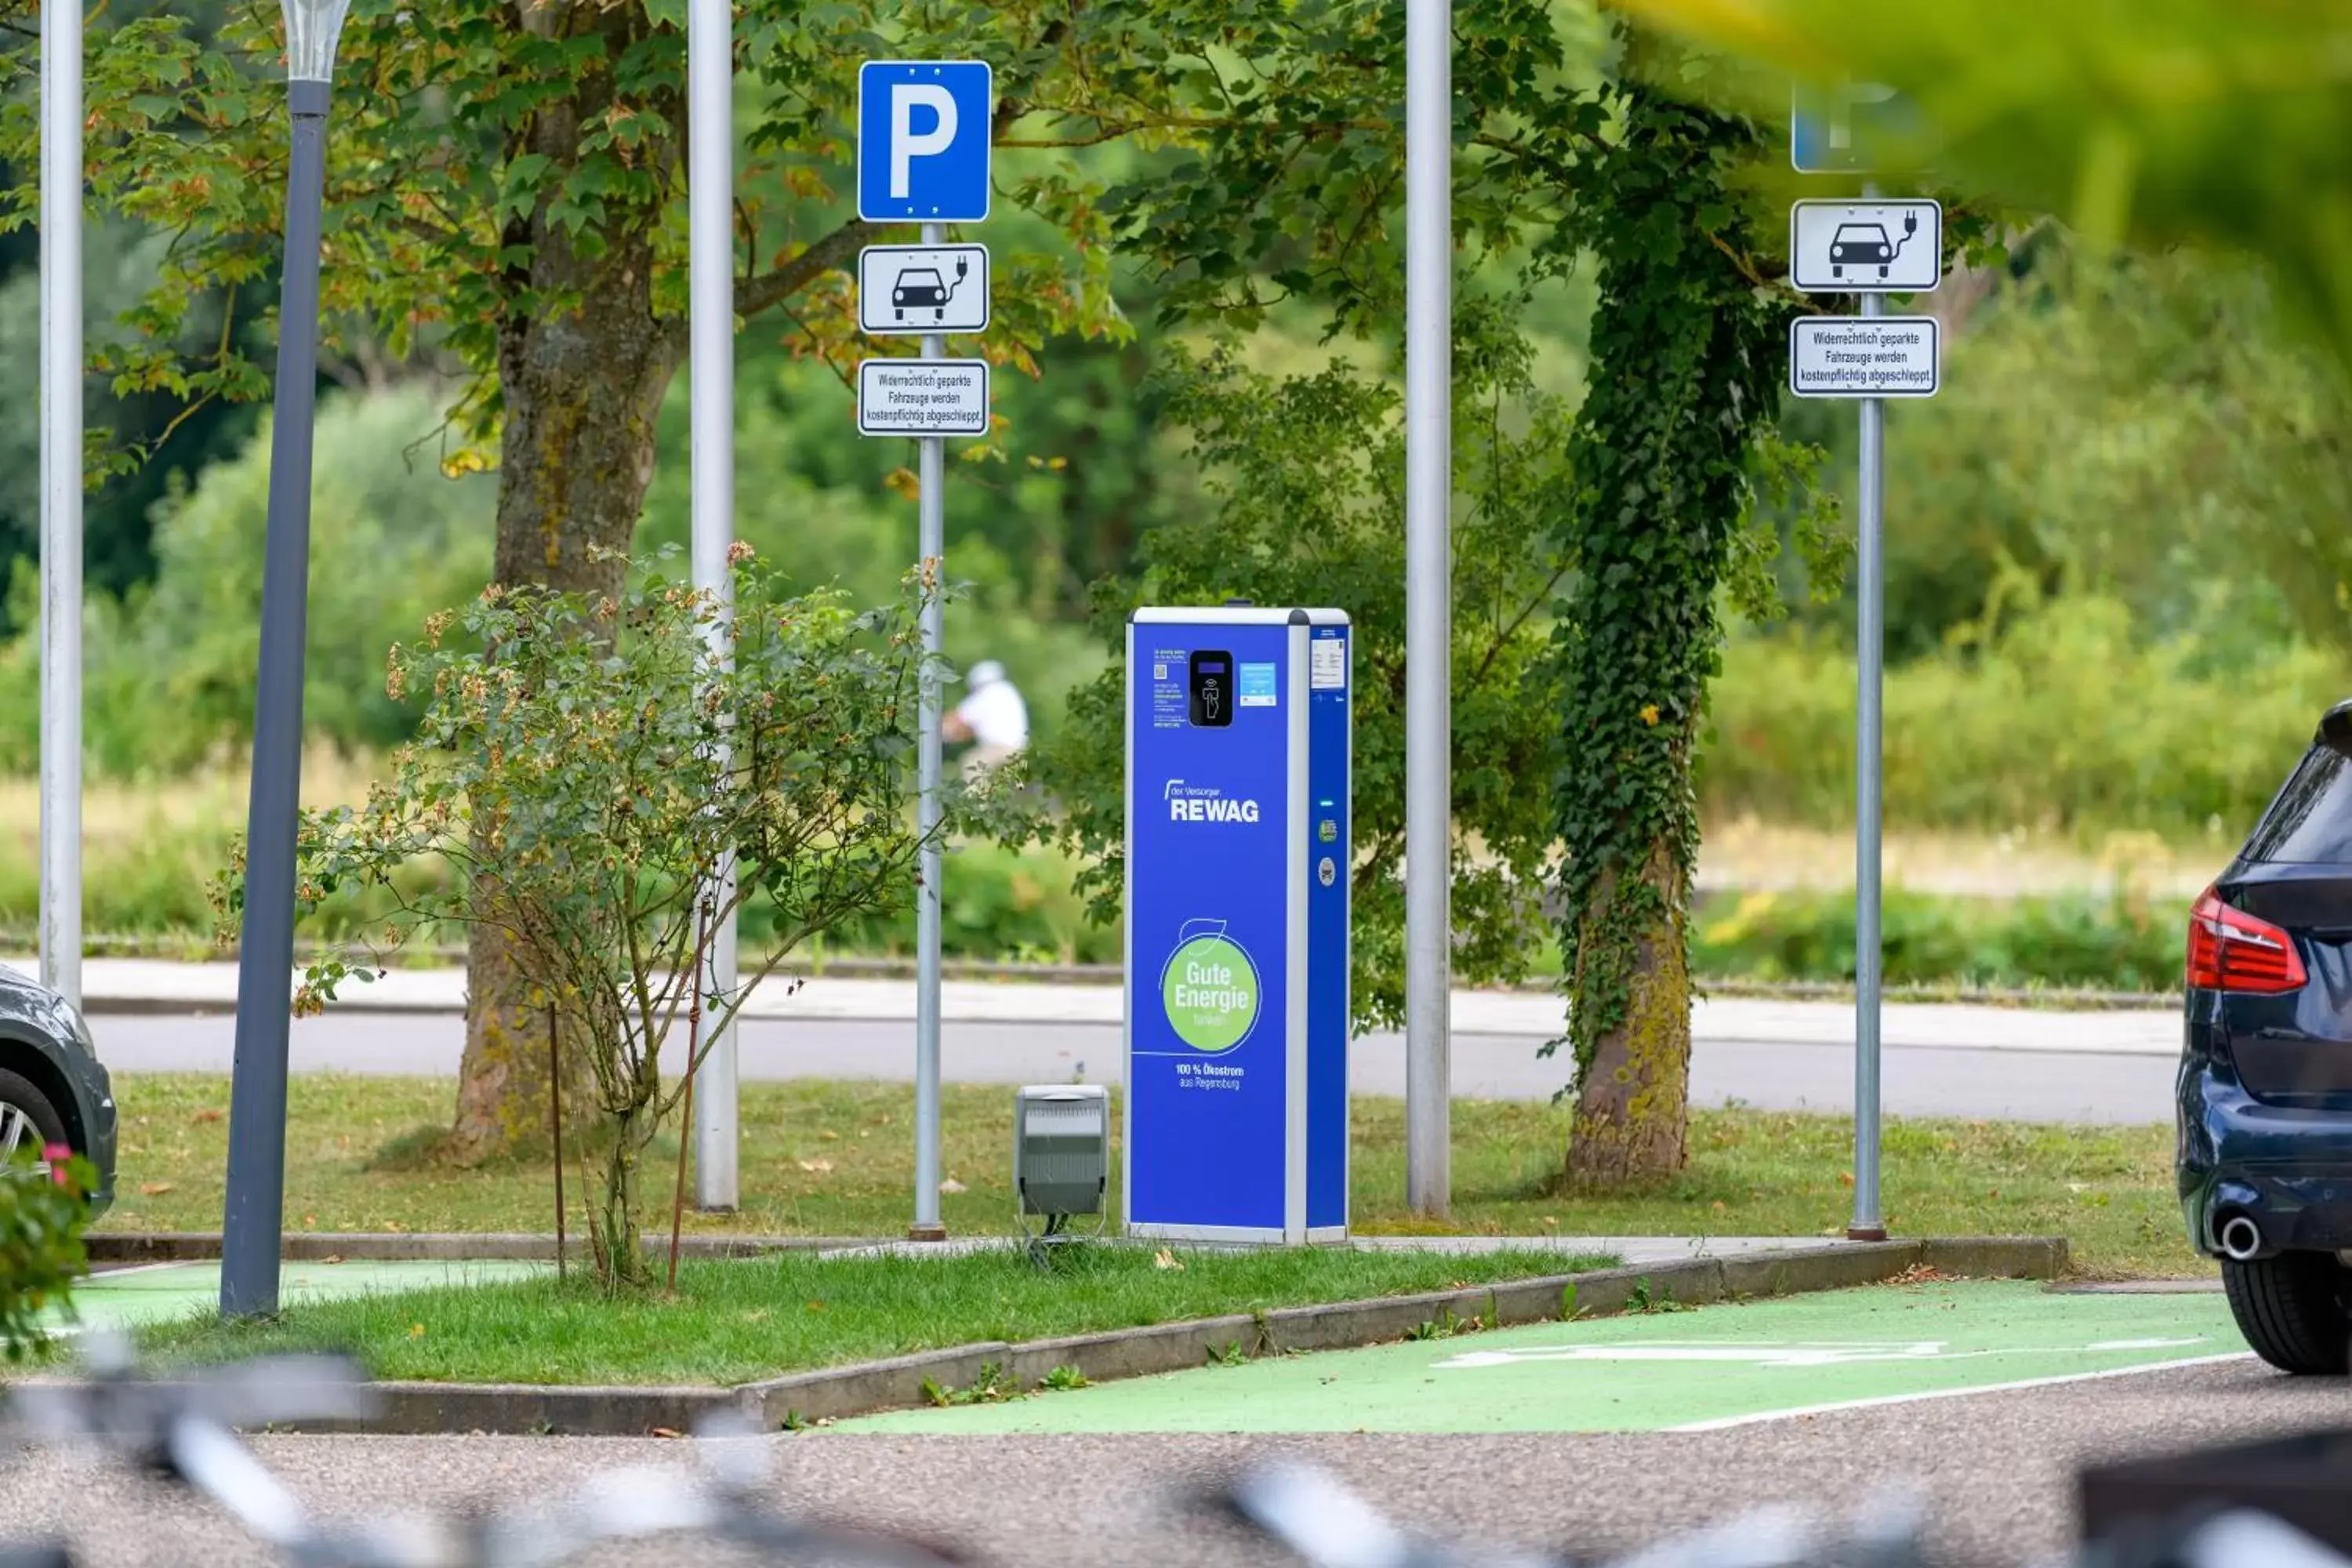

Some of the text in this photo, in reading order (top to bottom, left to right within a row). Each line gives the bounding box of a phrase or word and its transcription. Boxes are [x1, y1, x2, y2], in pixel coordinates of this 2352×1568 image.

[890, 84, 958, 198] P
[1813, 332, 1920, 347] Widerrechtlich geparkte
[1826, 351, 1907, 365] Fahrzeuge werden
[877, 374, 971, 389] Widerrechtlich geparkte
[1801, 368, 1866, 385] kostenpflichtig
[888, 391, 961, 406] Fahrzeuge werden
[866, 409, 924, 424] kostenpflichtig
[1171, 799, 1258, 822] REWAG
[1187, 961, 1231, 985] Gute
[1175, 983, 1248, 1014] Energie
[1177, 1062, 1244, 1076] 100 % Ökostrom
